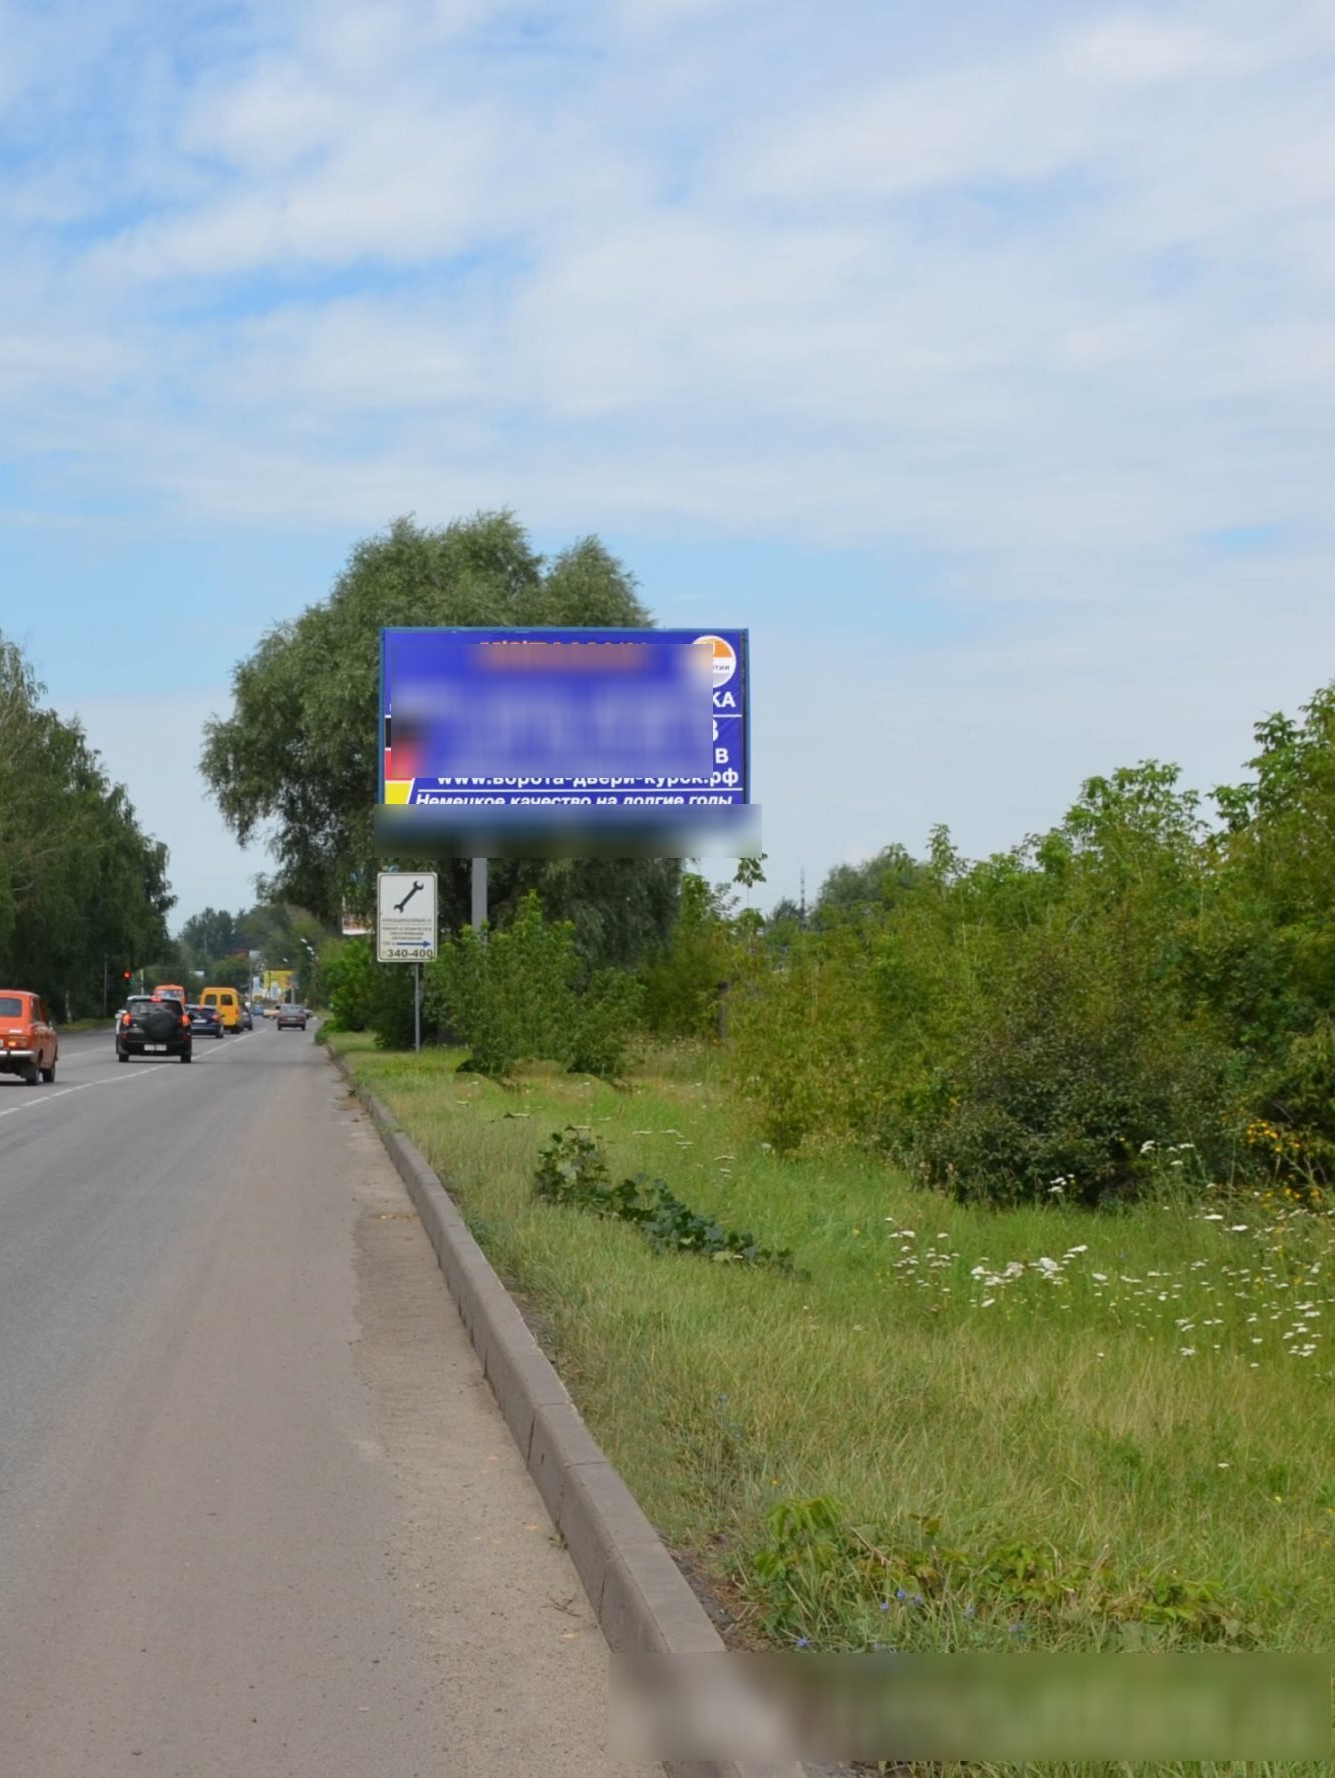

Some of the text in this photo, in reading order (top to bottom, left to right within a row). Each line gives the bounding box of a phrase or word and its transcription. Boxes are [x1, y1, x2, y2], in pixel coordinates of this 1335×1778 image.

[510, 796, 591, 805] качество
[596, 796, 617, 805] на
[623, 796, 684, 805] долгие
[689, 796, 733, 805] годы
